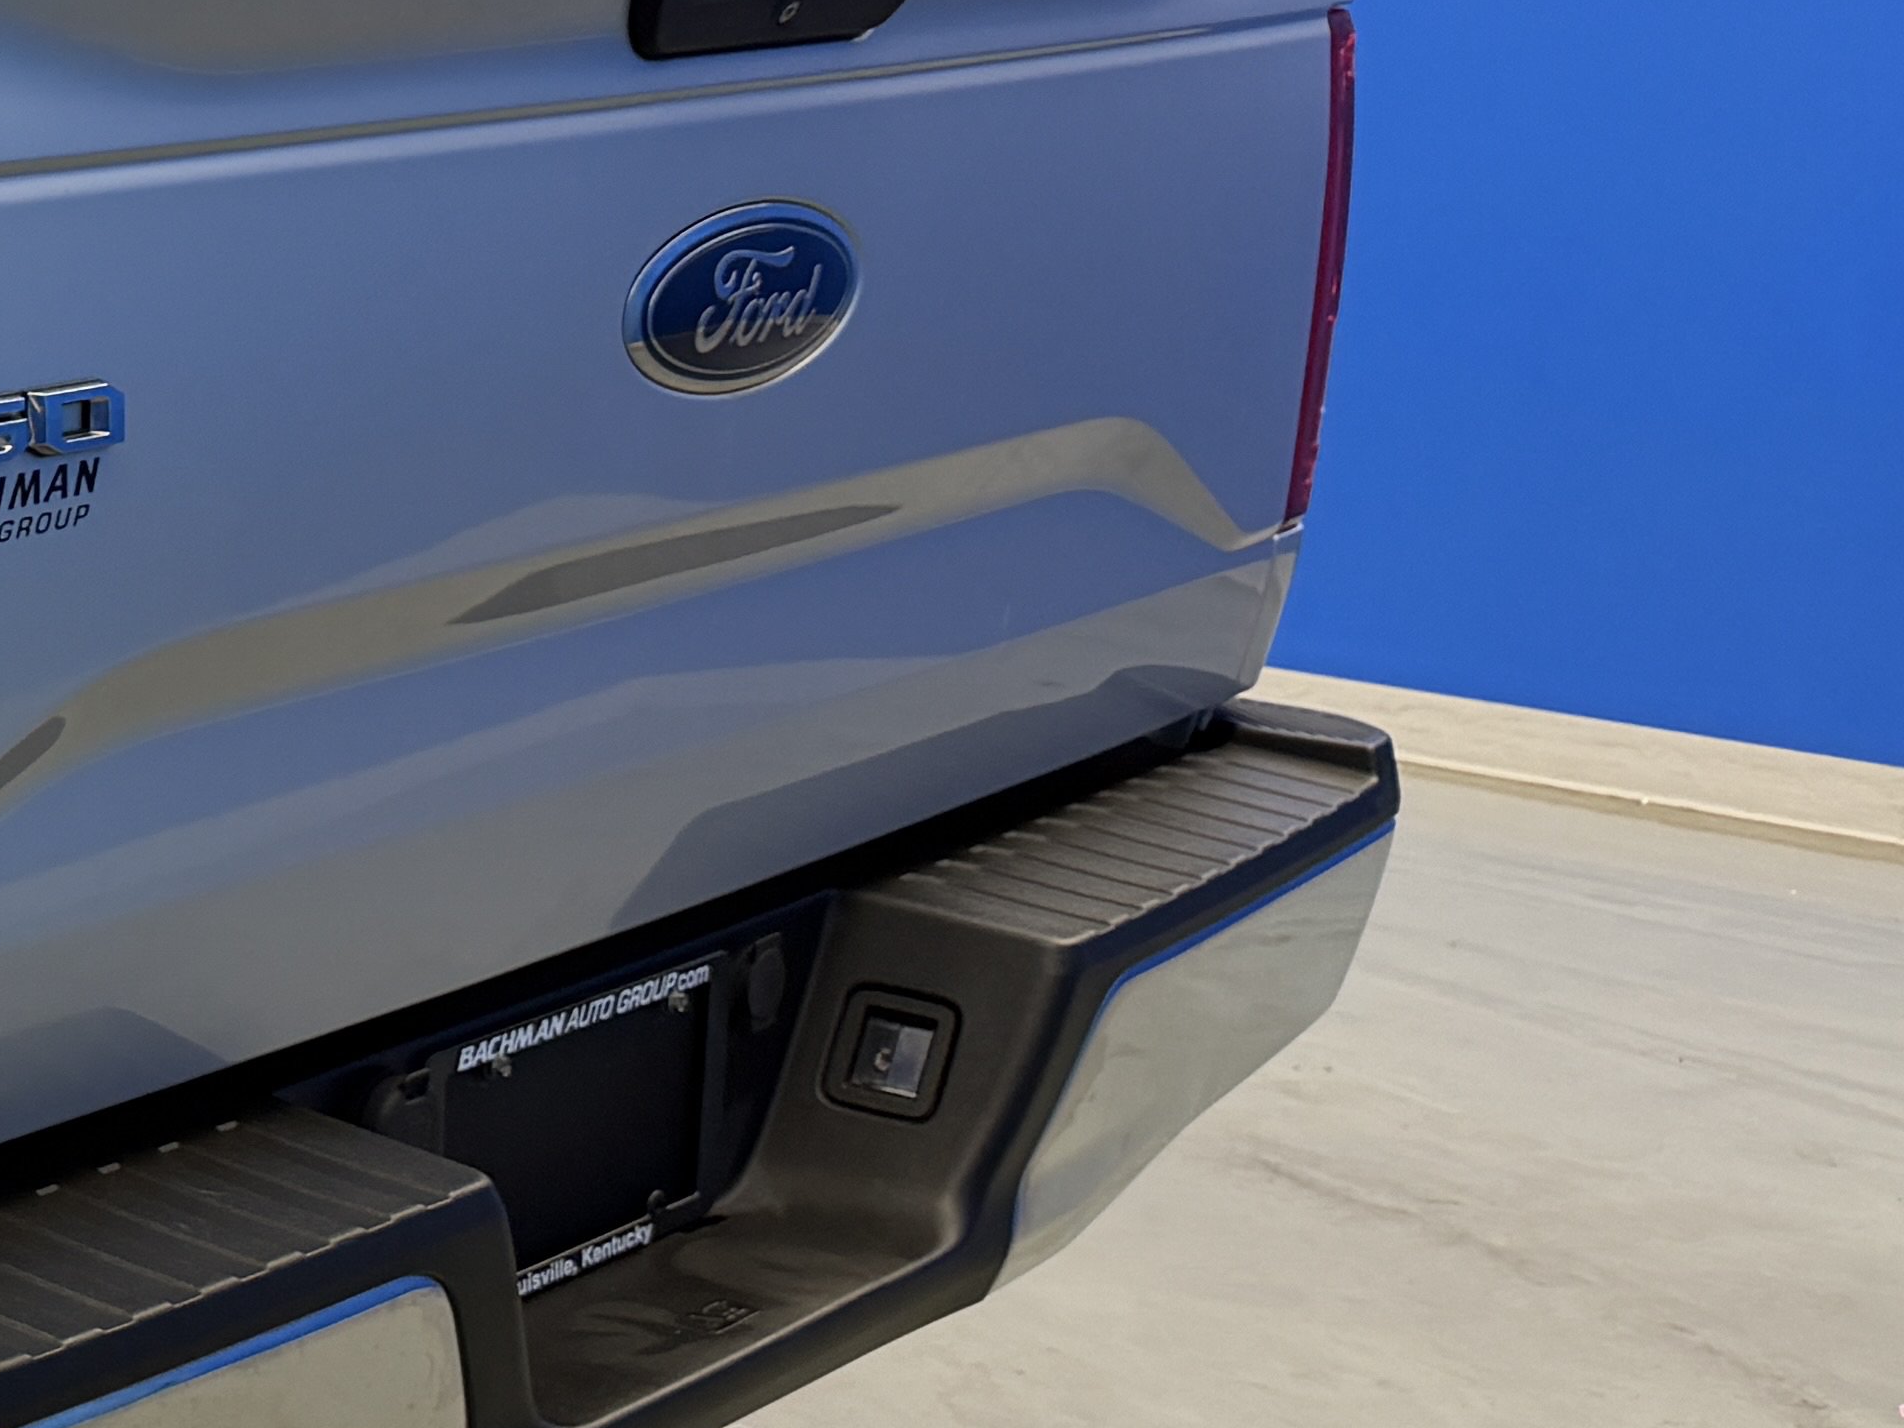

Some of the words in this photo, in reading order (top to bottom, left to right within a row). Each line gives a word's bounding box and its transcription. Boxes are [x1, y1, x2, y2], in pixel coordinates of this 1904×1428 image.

[694, 245, 822, 354] Ford
[457, 1012, 567, 1072] BACHMAN
[564, 994, 616, 1033] AUTO
[616, 965, 710, 1014] GROUPcom
[516, 1258, 578, 1296] uisville,
[581, 1223, 654, 1268] Kentucky
